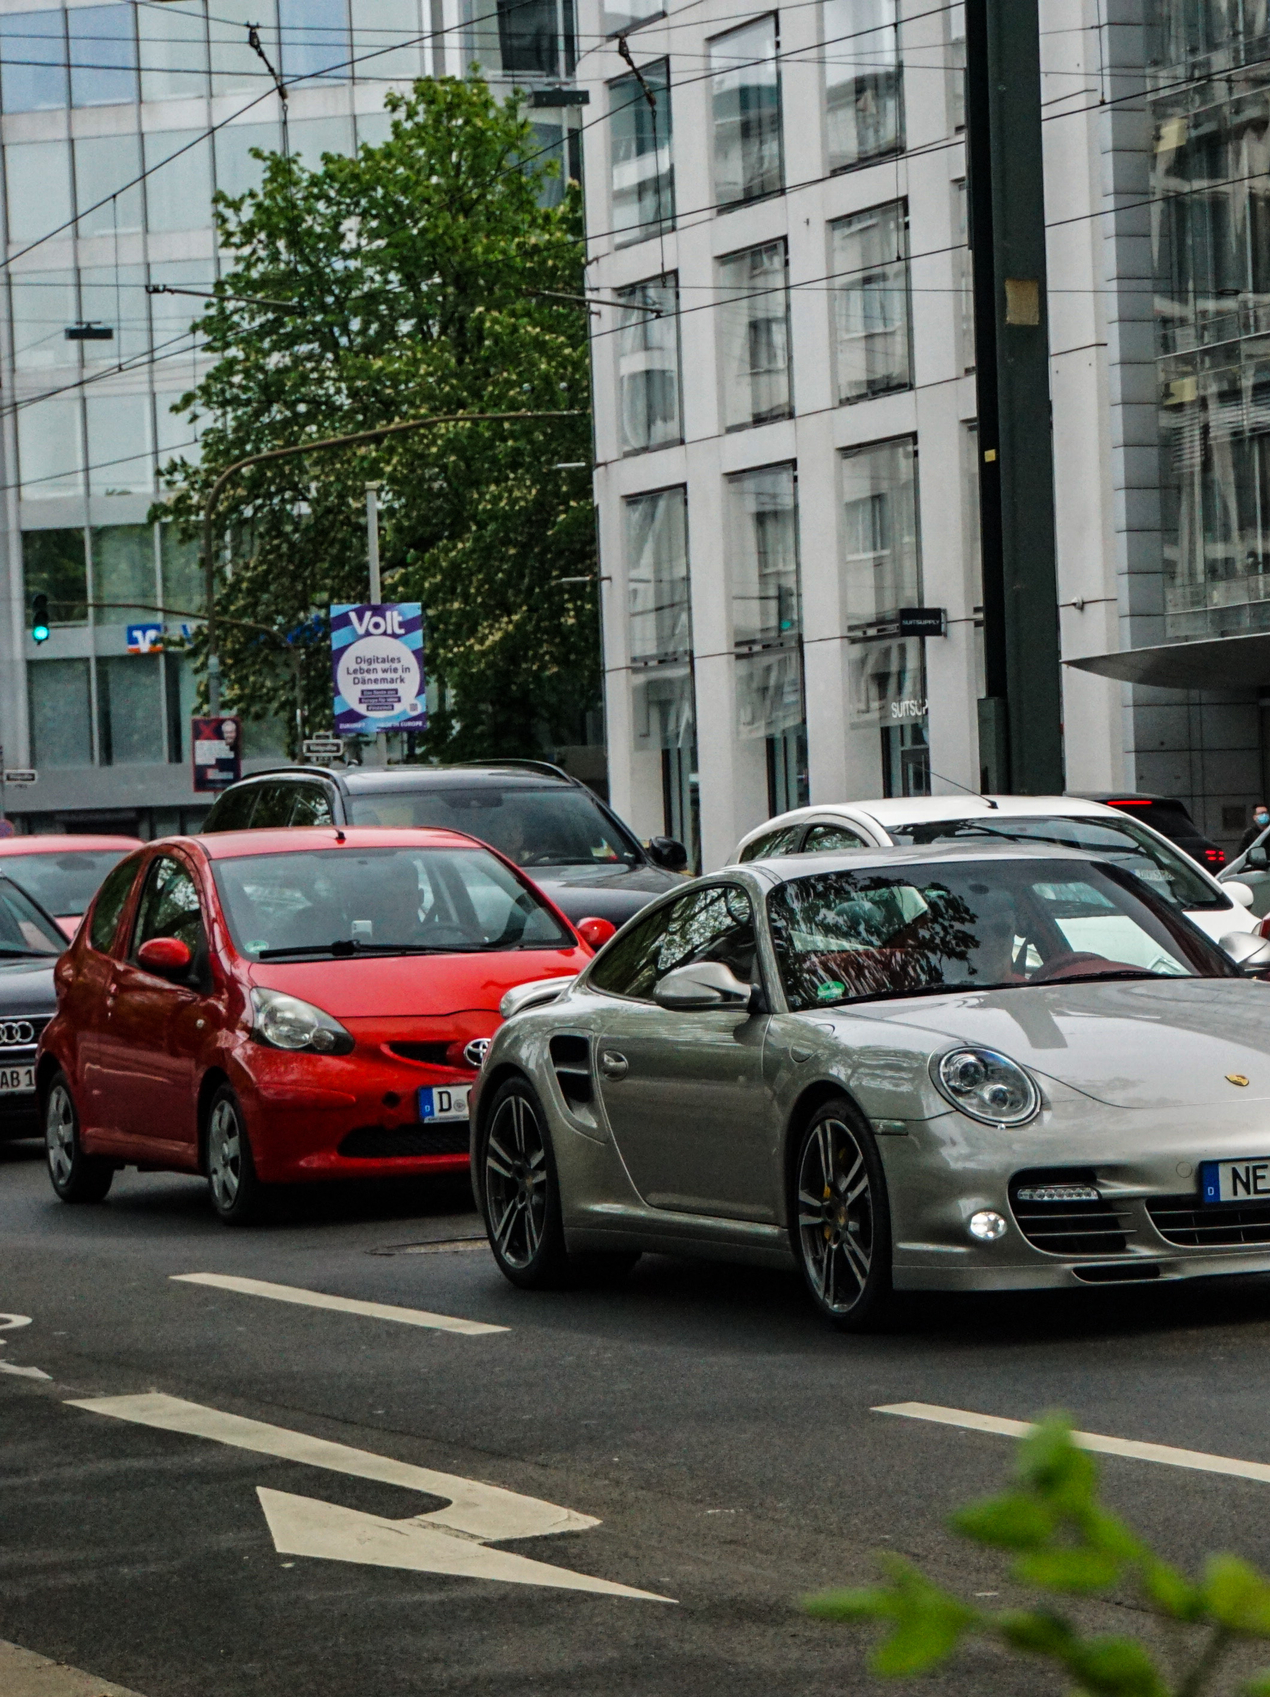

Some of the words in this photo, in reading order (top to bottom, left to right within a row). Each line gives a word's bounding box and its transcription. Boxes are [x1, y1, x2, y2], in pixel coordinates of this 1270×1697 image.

[347, 610, 406, 635] Volt
[346, 666, 378, 675] Leben
[381, 665, 399, 674] wie
[401, 664, 411, 674] in
[355, 654, 402, 666] Digitales
[352, 675, 406, 686] Dänemark
[0, 1070, 21, 1089] AB
[25, 1069, 35, 1087] 1
[437, 1090, 452, 1113] D
[1231, 1163, 1270, 1197] NE
